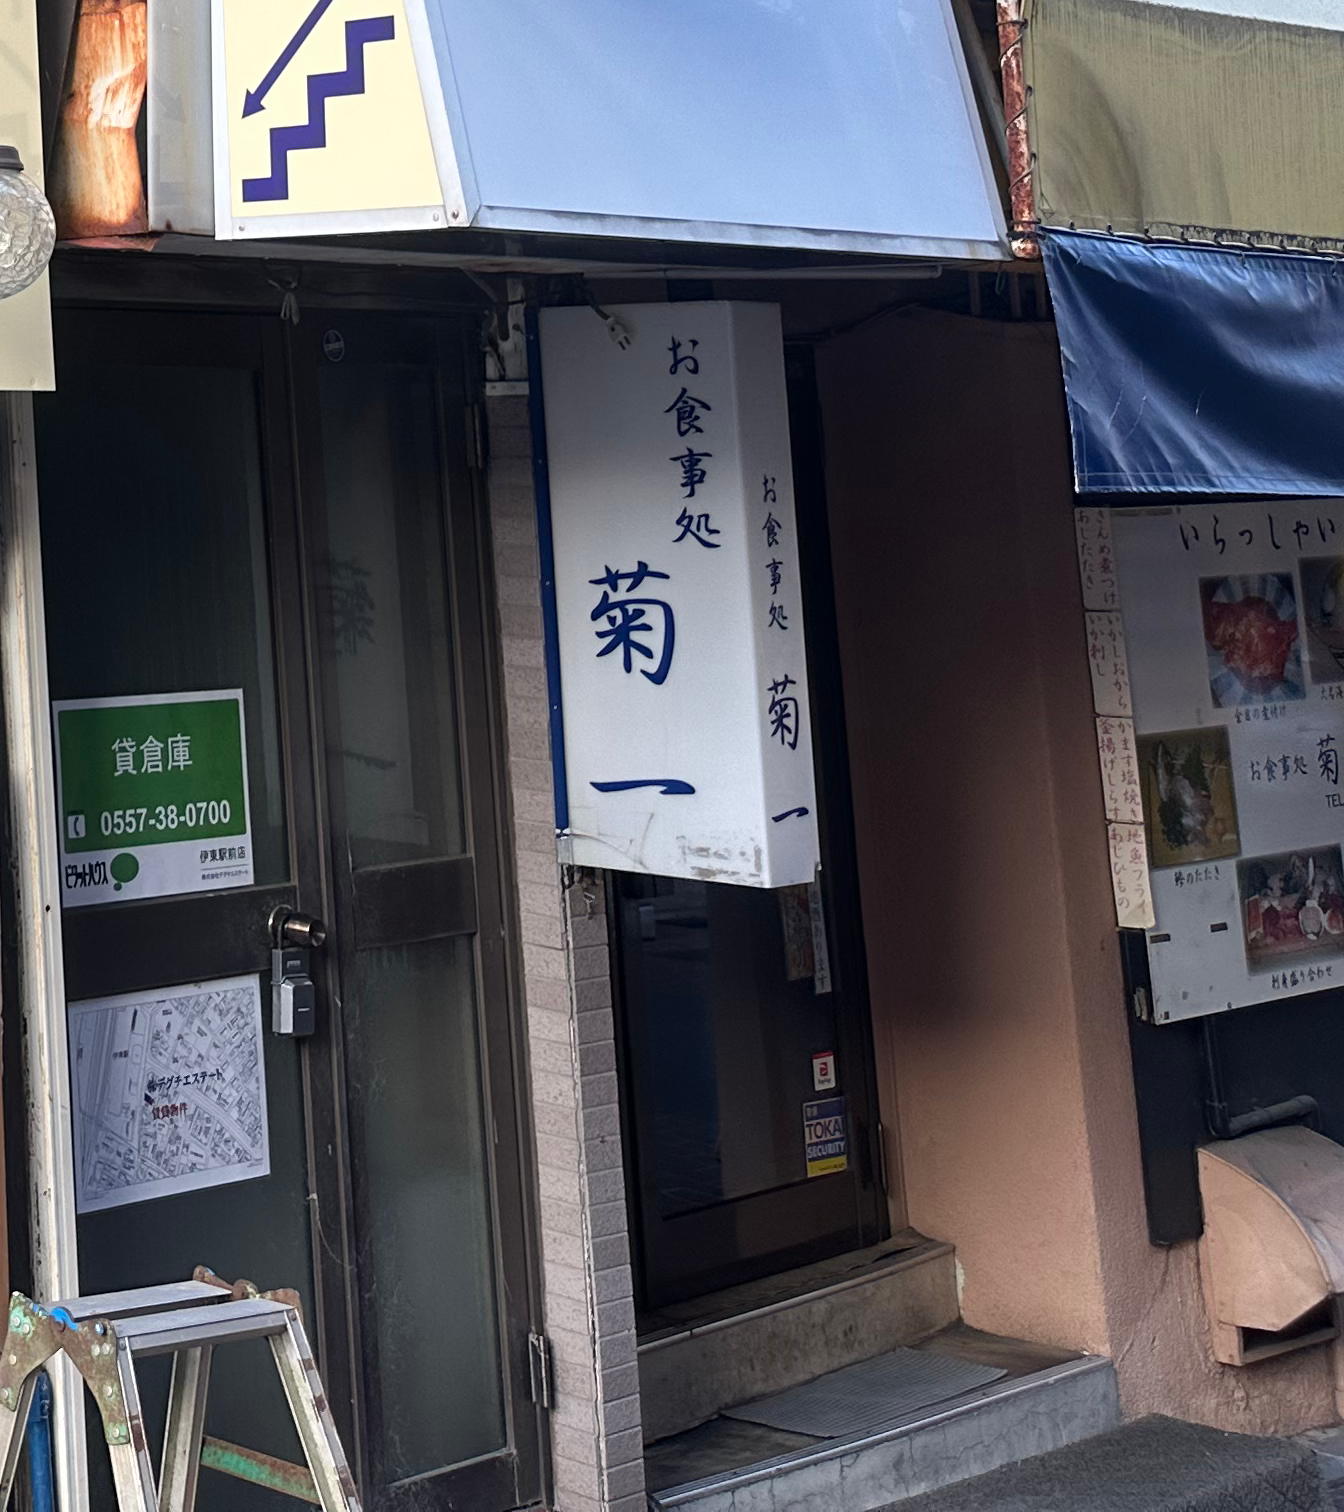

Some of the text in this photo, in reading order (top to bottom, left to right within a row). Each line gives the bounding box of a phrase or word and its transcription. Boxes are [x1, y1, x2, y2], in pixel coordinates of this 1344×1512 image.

[664, 335, 721, 549] お食事処
[1179, 513, 1336, 555] いらっしゃい
[761, 474, 810, 823] お食事処 菊一
[1089, 614, 1105, 677] いか刺し
[589, 561, 696, 795] 菊一
[111, 733, 193, 777] 貸倉庫
[1117, 721, 1140, 821] かます塩焼き
[1250, 734, 1339, 785] お食事処 菊
[100, 800, 231, 836] 0557-38-0700
[1325, 793, 1344, 809] TEL
